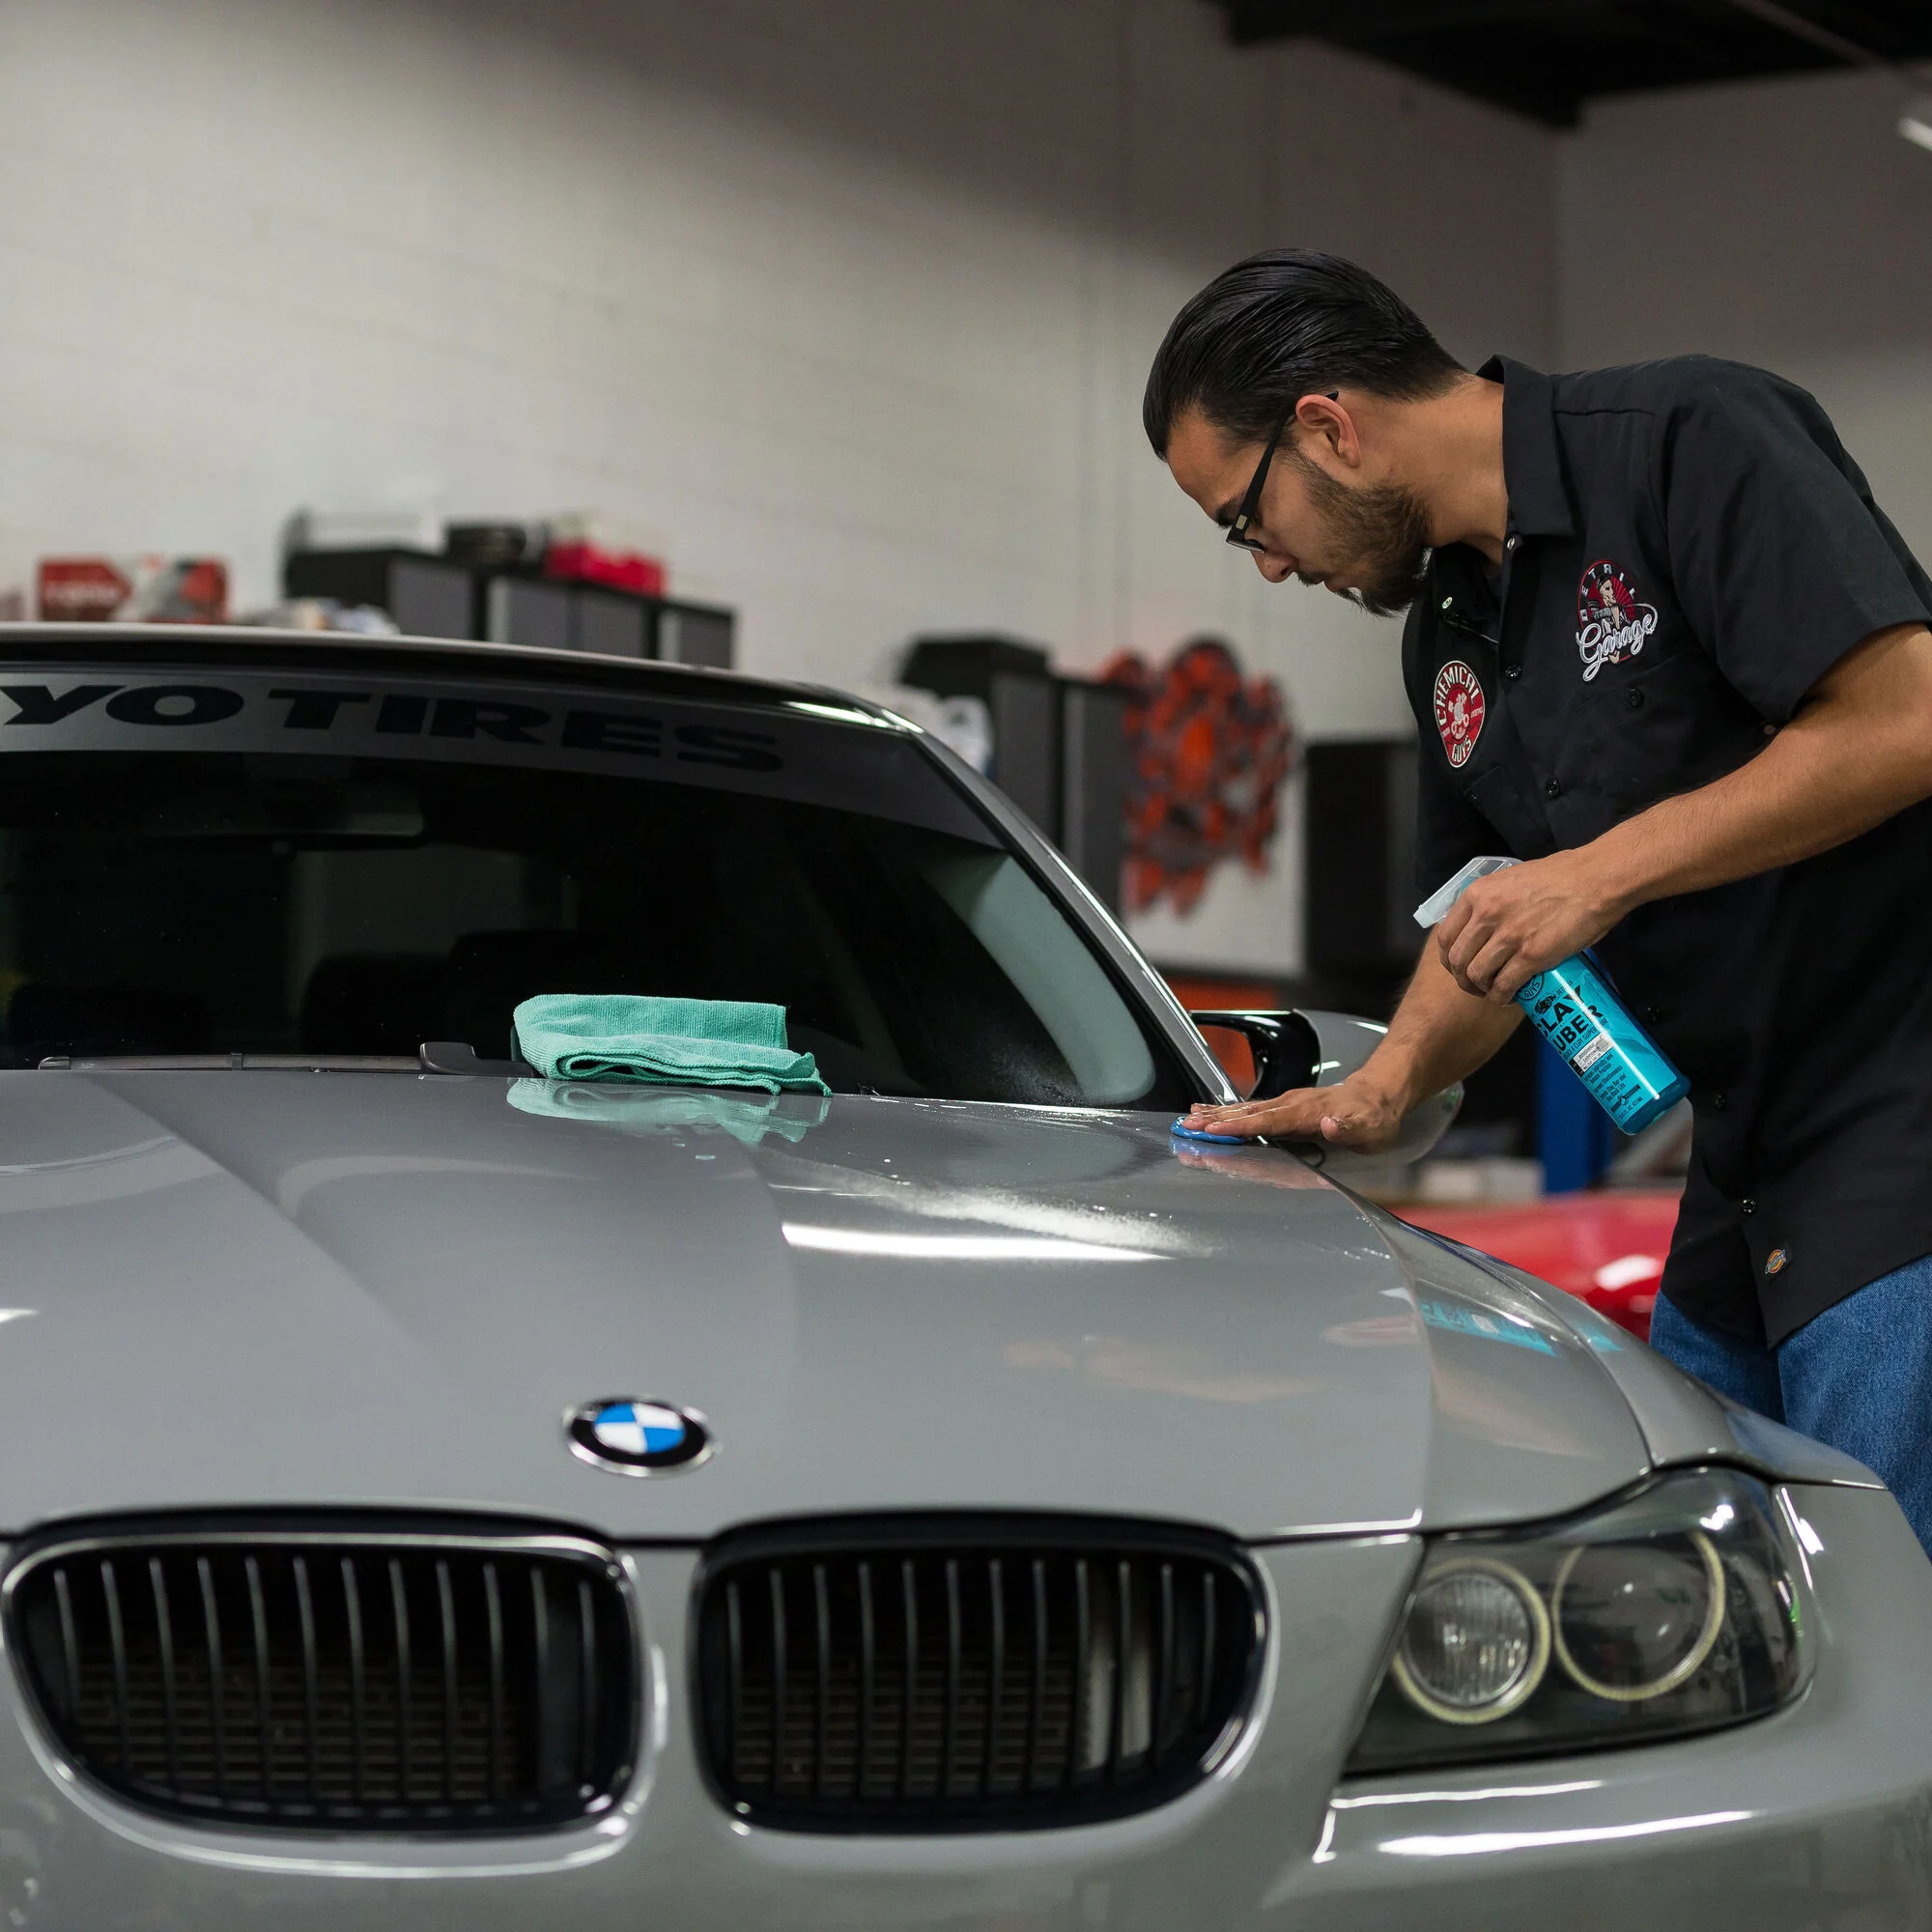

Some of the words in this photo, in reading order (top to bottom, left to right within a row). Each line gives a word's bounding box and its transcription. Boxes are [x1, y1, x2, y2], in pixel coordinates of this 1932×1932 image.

[1579, 563, 1636, 622] DETAIL
[1576, 603, 1659, 682] Garage
[1435, 666, 1480, 726] CHEMICAL
[0, 684, 244, 726] YO
[267, 688, 784, 774] TIRES
[1451, 734, 1472, 763] GUYS
[1522, 981, 1540, 998] GUYS
[1551, 1004, 1604, 1054] UBER
[1581, 1025, 1598, 1040] SUPER
